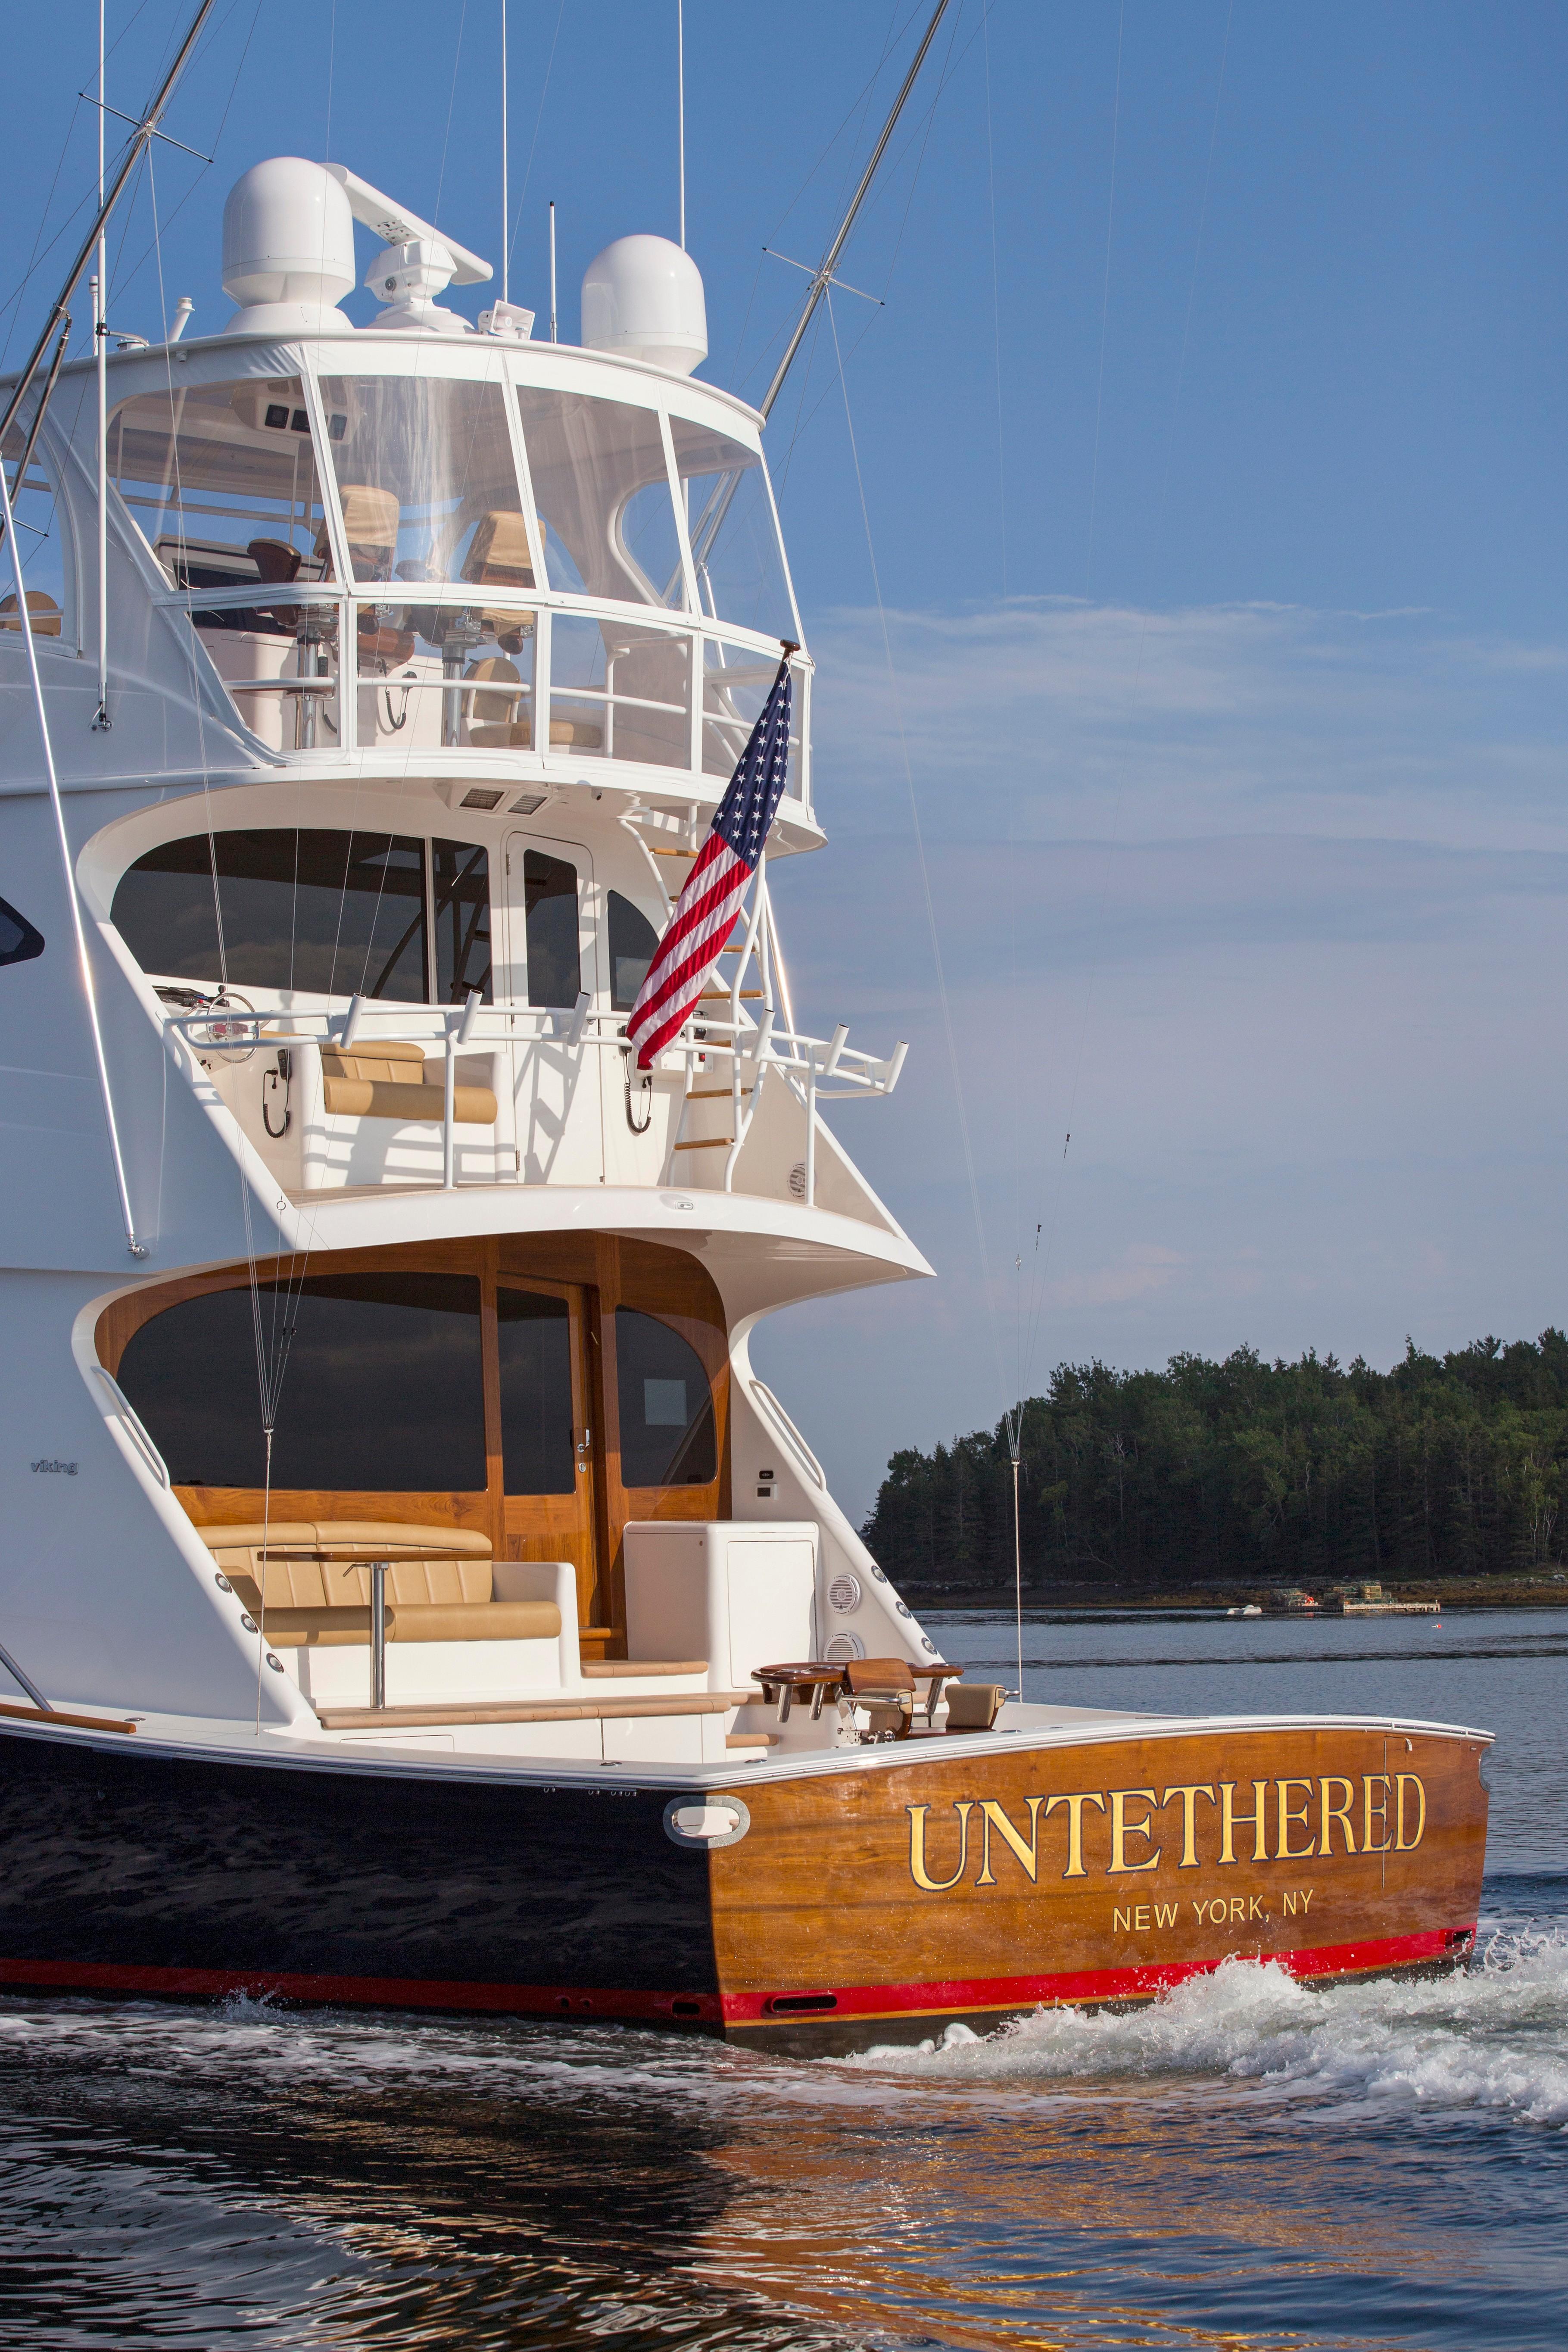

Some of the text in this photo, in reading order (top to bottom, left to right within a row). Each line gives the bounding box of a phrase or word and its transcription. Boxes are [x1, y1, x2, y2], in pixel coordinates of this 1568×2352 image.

[31, 1460, 78, 1476] viking
[905, 1772, 1426, 1892] UNTETHERED
[1113, 1889, 1314, 1933] NEW YORK, NY
